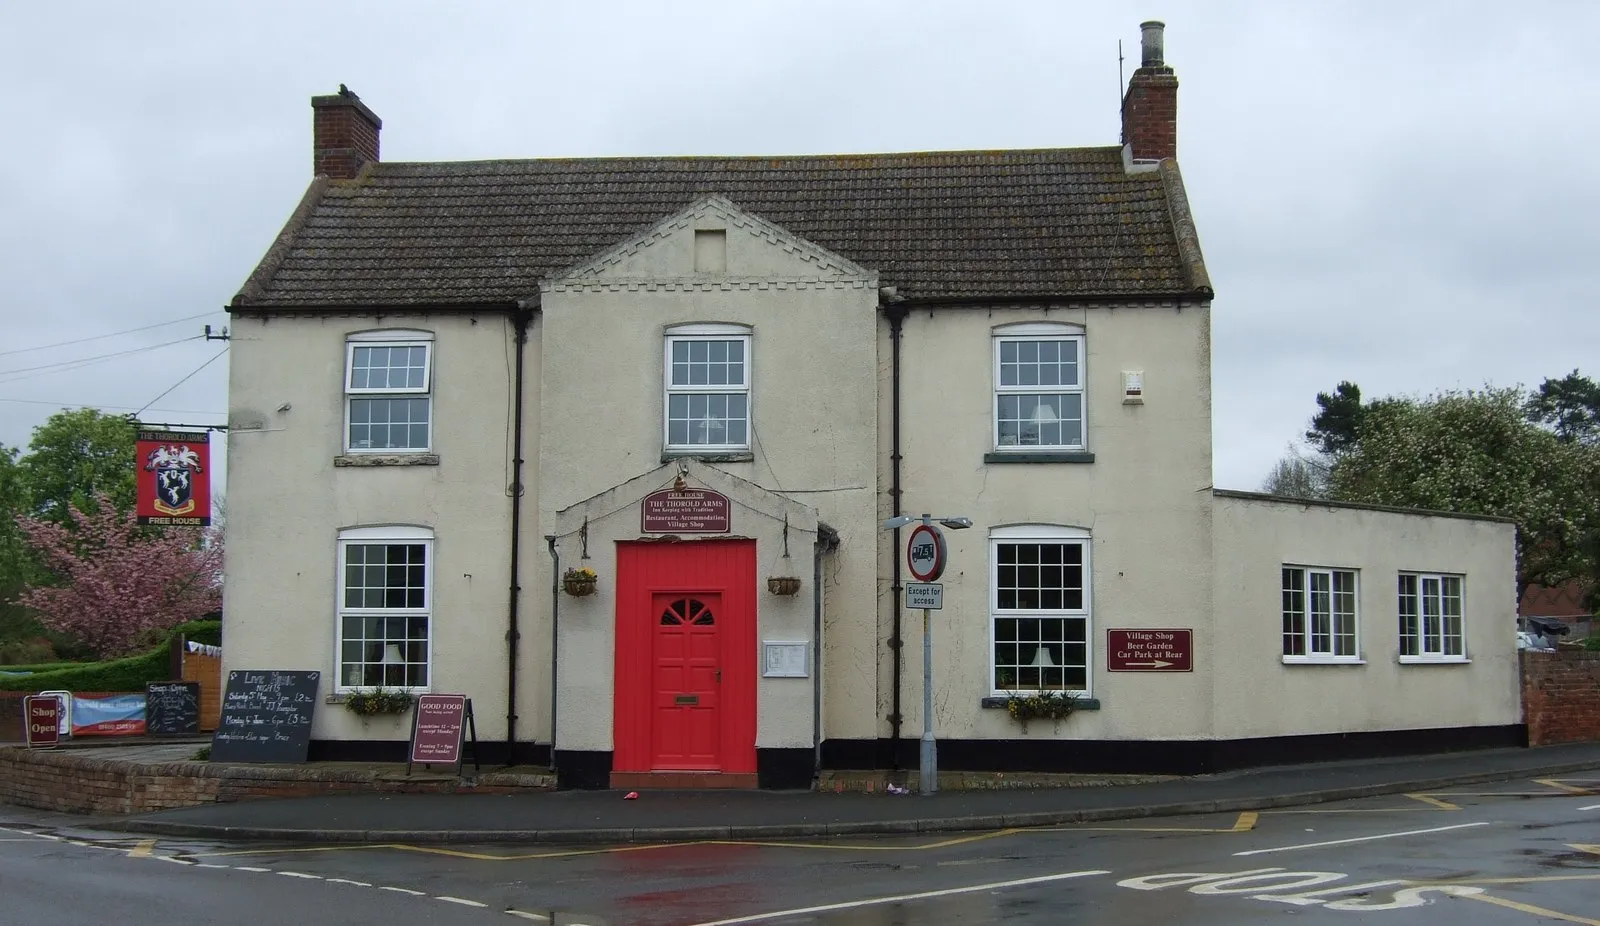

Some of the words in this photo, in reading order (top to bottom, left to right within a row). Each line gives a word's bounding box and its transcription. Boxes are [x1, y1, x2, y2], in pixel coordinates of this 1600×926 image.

[140, 432, 153, 440] THE
[155, 432, 185, 441] THOROLD
[919, 546, 929, 556] 7.5
[908, 587, 929, 595] Except
[1126, 632, 1153, 640] Village
[1155, 632, 1174, 640] Shop
[32, 707, 55, 717] Shop
[225, 715, 244, 727] Monday
[32, 723, 56, 733] Open
[1116, 867, 1486, 911] STOP
